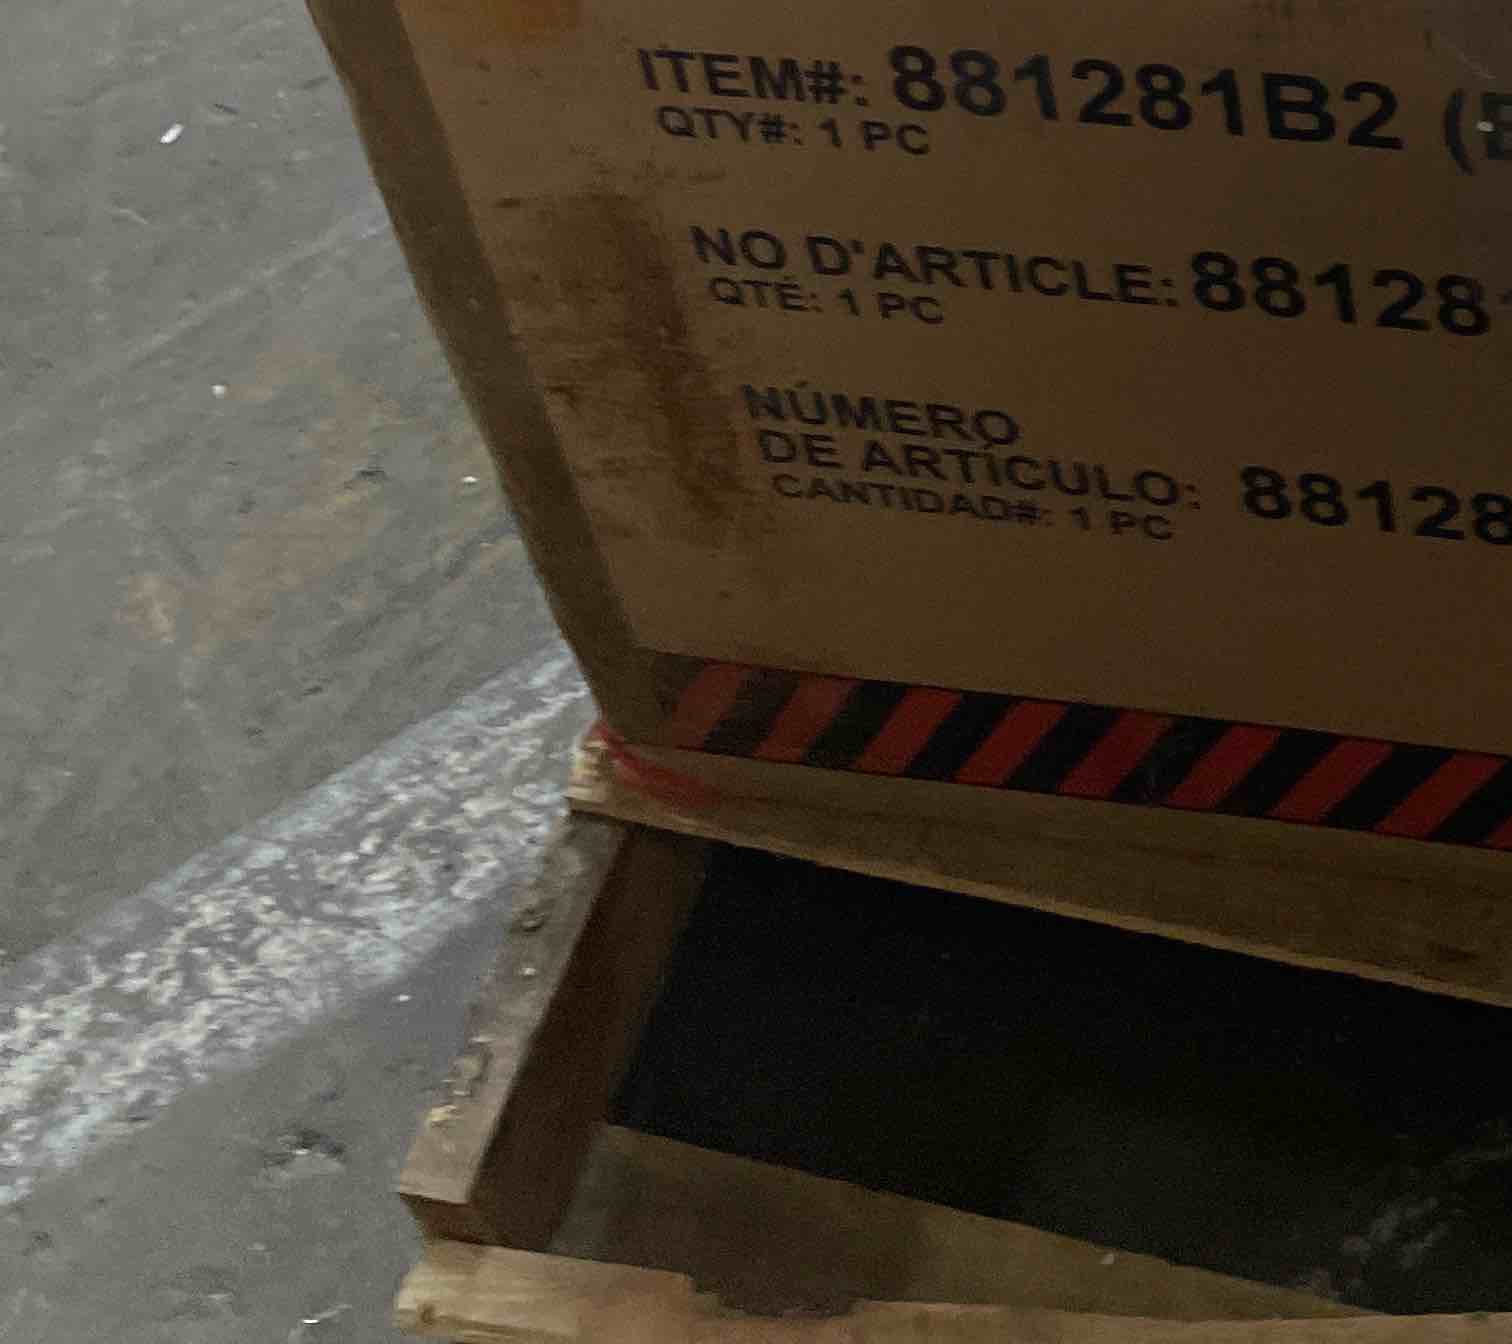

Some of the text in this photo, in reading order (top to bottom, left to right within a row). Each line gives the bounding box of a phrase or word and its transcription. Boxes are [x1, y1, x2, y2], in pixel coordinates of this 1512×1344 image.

[638, 49, 869, 108] ITEM#:
[889, 45, 1405, 151] 881281B2
[656, 106, 931, 157] QTY#: 1 PC
[690, 225, 787, 270] NO
[808, 234, 1179, 308] D'ARTICLE:
[839, 287, 860, 318] 1
[879, 292, 945, 326] PC
[743, 380, 1022, 447] NÚMERO
[757, 428, 843, 470] DE
[771, 473, 1173, 544] CANTIDAD#: 1 PC
